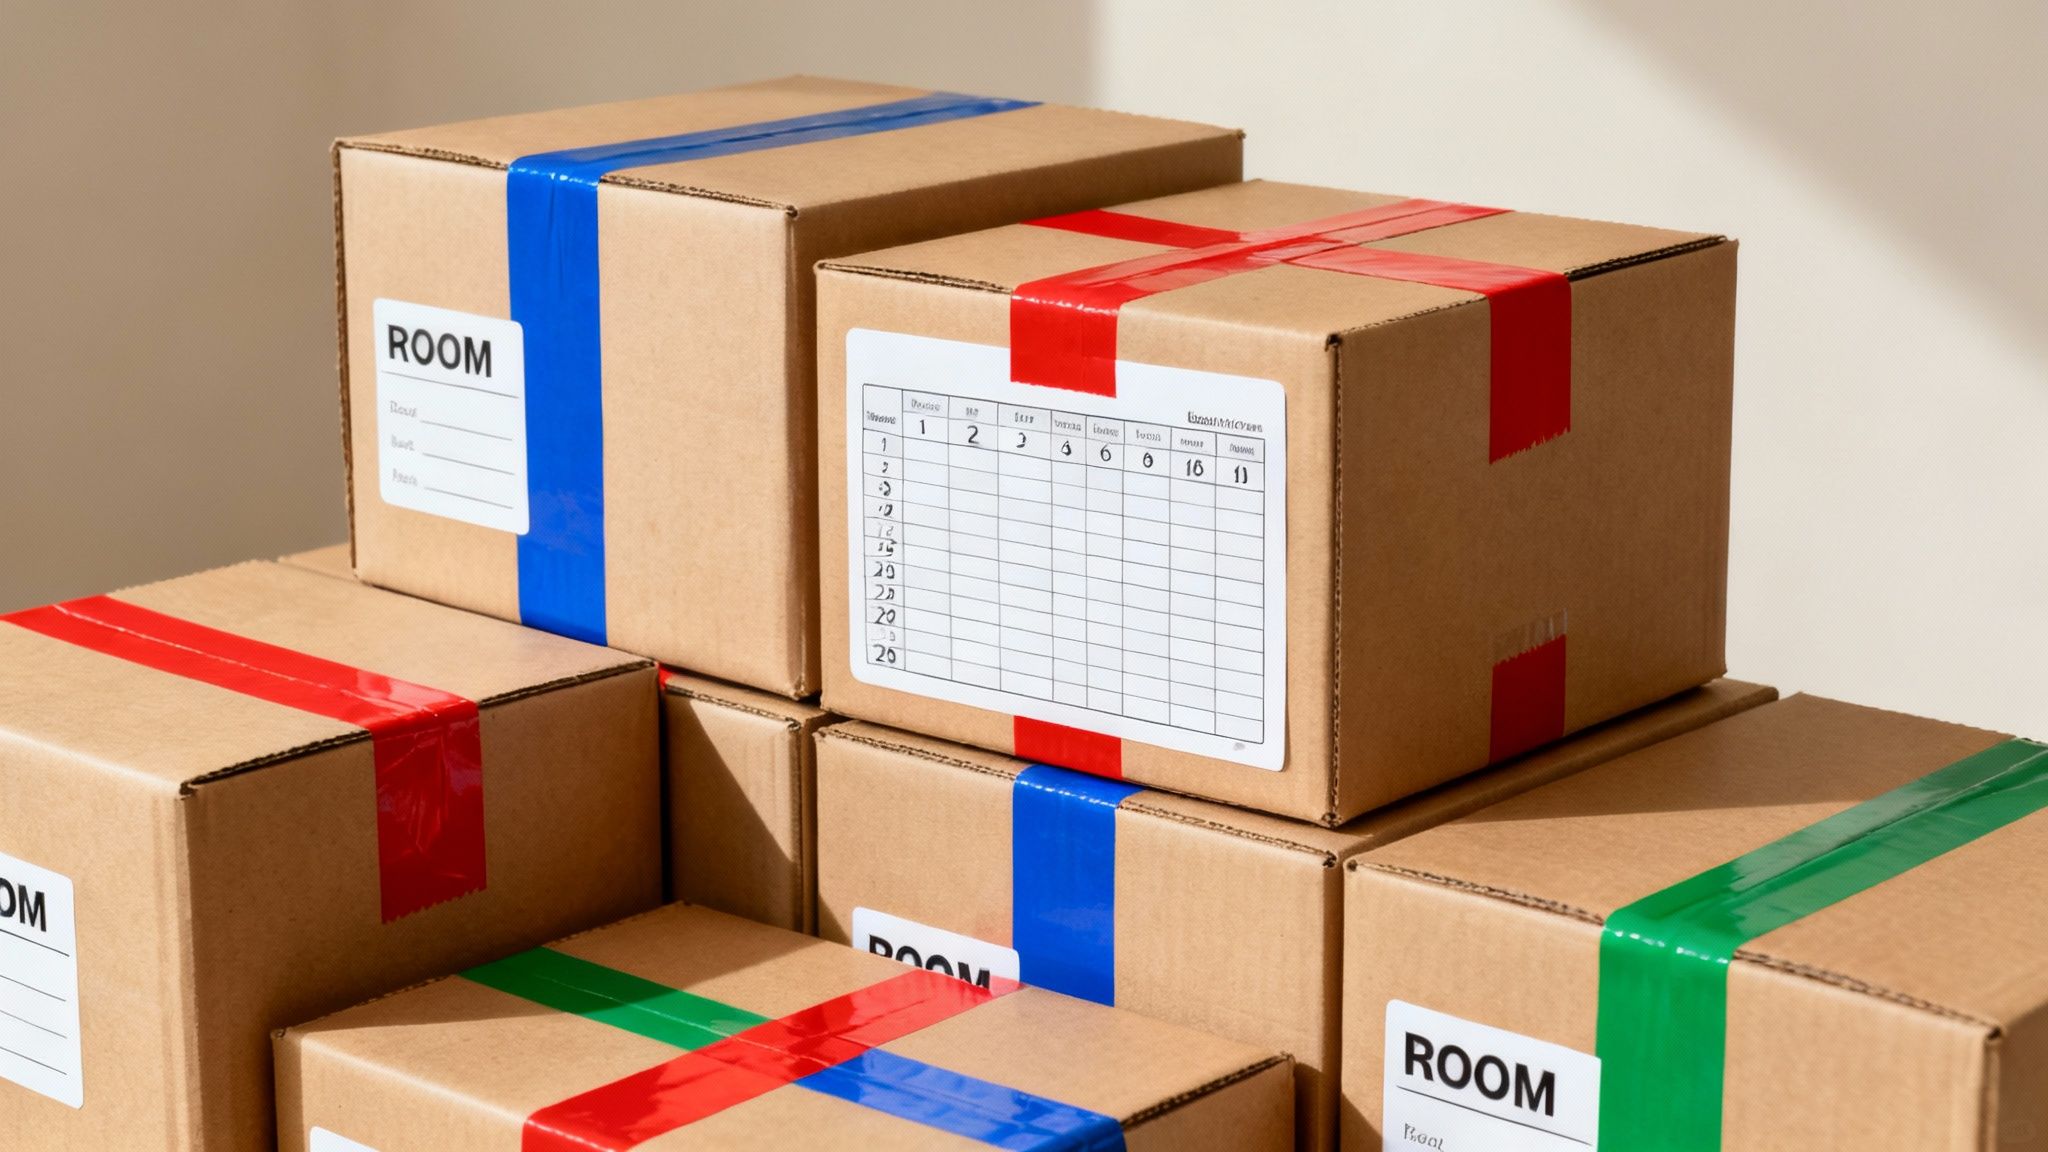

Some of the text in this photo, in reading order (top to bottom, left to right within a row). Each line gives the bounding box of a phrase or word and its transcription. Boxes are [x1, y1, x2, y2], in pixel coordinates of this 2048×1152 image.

[388, 324, 492, 378] ROOM
[920, 419, 926, 435] 1
[967, 425, 980, 444] 2
[1404, 1031, 1556, 1117] ROOM
